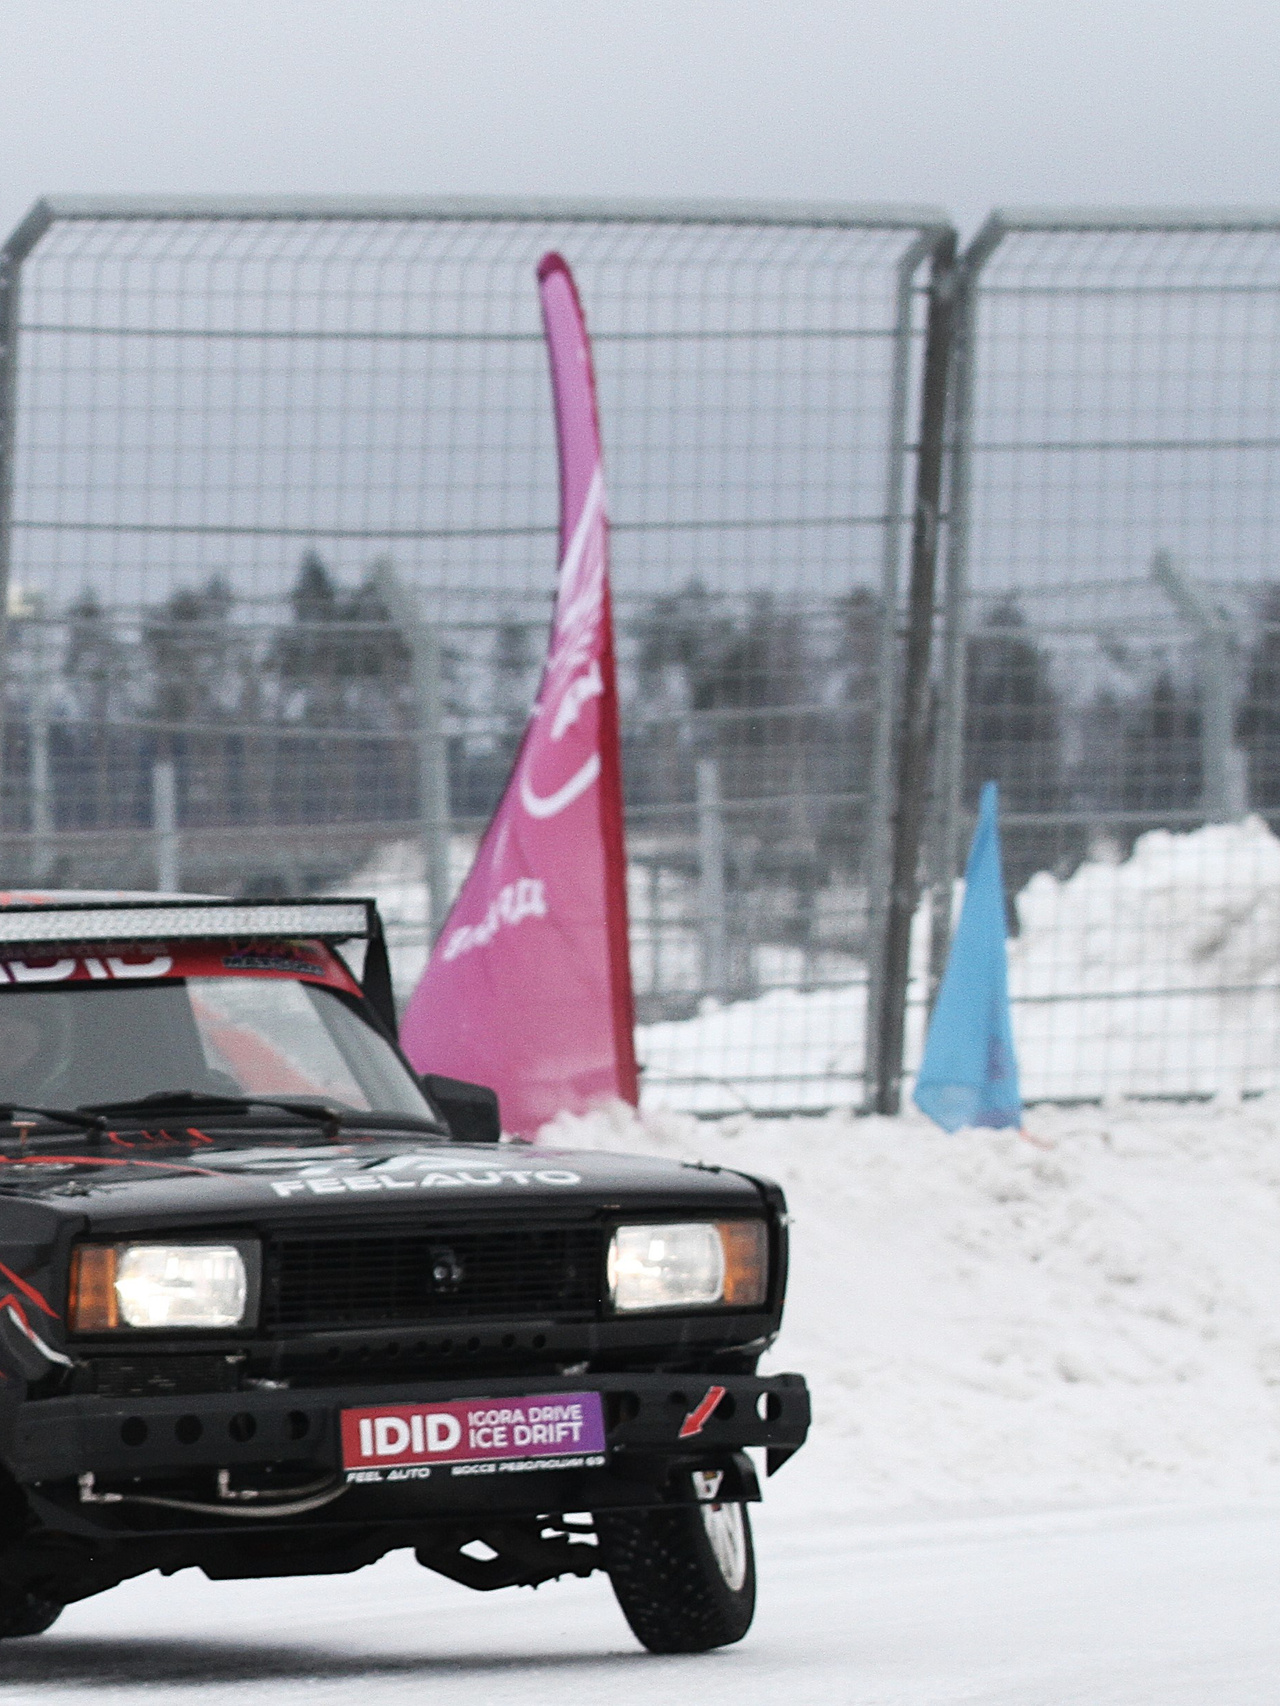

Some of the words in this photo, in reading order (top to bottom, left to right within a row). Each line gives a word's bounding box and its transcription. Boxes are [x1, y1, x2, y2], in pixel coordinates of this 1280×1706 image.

[271, 1169, 582, 1198] FEELAUTO
[467, 1408, 526, 1428] IGORA
[528, 1403, 583, 1423] DRIVE
[359, 1412, 461, 1458] IDID
[468, 1426, 509, 1449] ICE
[513, 1421, 583, 1446] DRIFT
[346, 1470, 383, 1484] FEEL
[386, 1467, 432, 1481] AUTO
